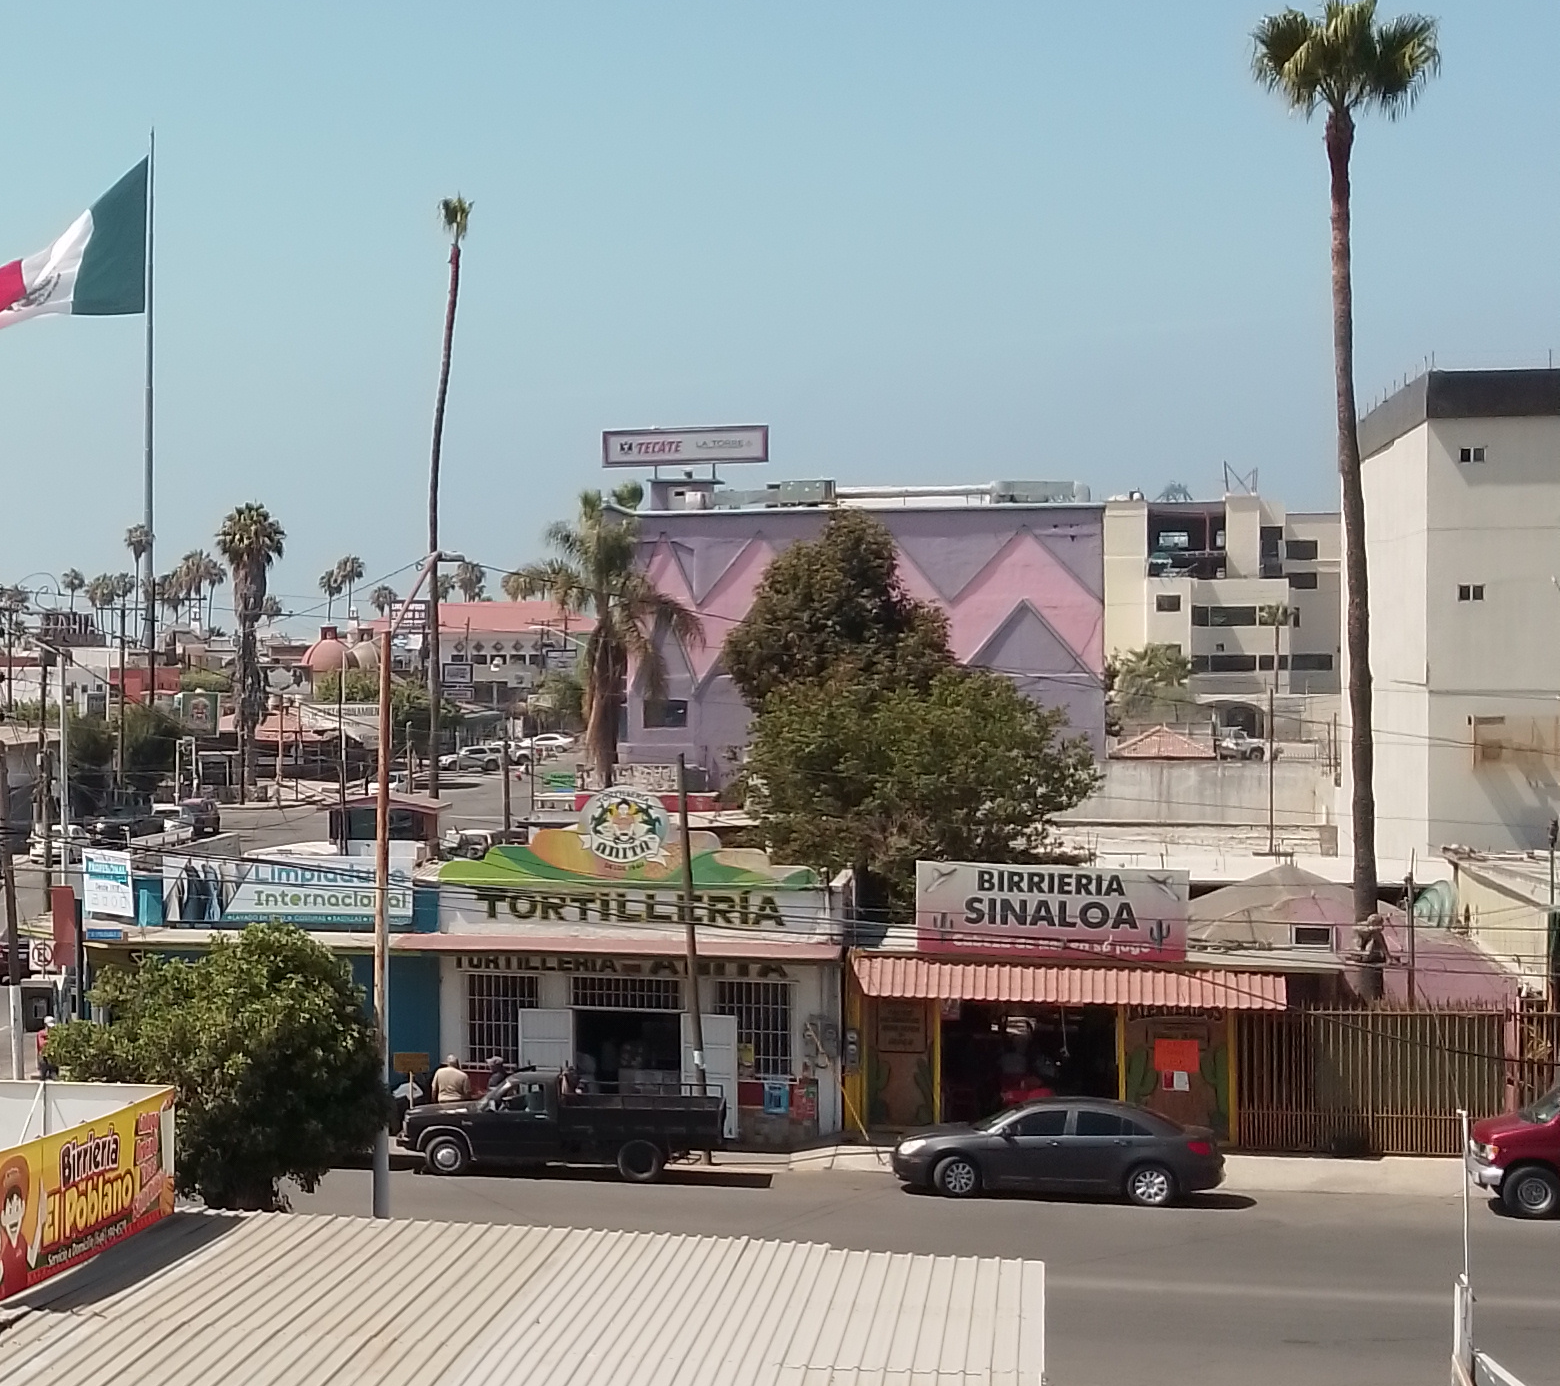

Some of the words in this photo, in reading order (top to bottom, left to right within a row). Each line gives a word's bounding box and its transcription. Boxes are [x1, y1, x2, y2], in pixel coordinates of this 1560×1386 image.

[636, 441, 682, 454] TECATE
[713, 440, 743, 448] TORRE
[595, 840, 651, 860] ANITA
[977, 870, 1126, 897] BIRRIERIA
[963, 897, 1139, 930] SINALOA
[59, 1124, 121, 1190] Birriería
[42, 1190, 64, 1247] El
[65, 1168, 134, 1237] Poblano
